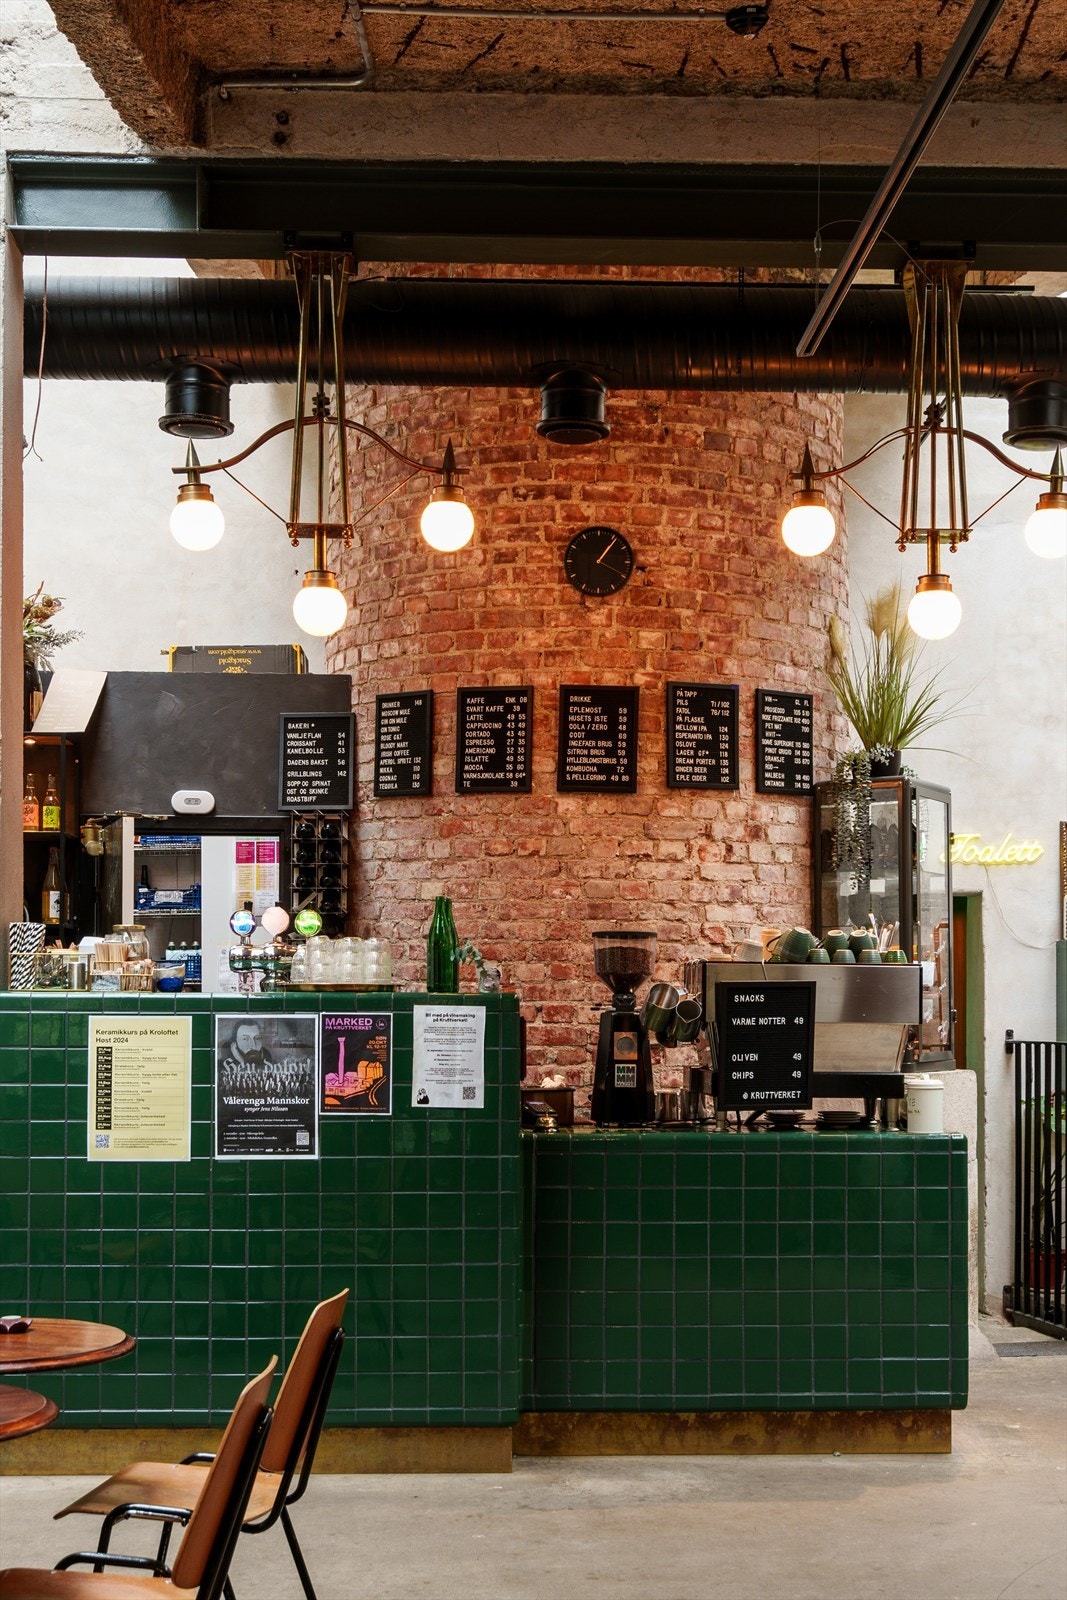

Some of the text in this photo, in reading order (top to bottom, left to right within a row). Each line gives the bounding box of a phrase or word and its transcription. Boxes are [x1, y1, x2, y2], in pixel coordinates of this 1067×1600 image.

[219, 657, 252, 665] Snackgold
[677, 688, 683, 697] PÅ
[940, 832, 1045, 864] Toalett
[325, 1018, 372, 1026] MARKED
[750, 1091, 801, 1099] KRUTTVERKET
[223, 1096, 310, 1106] Vålerenga Mannskor
